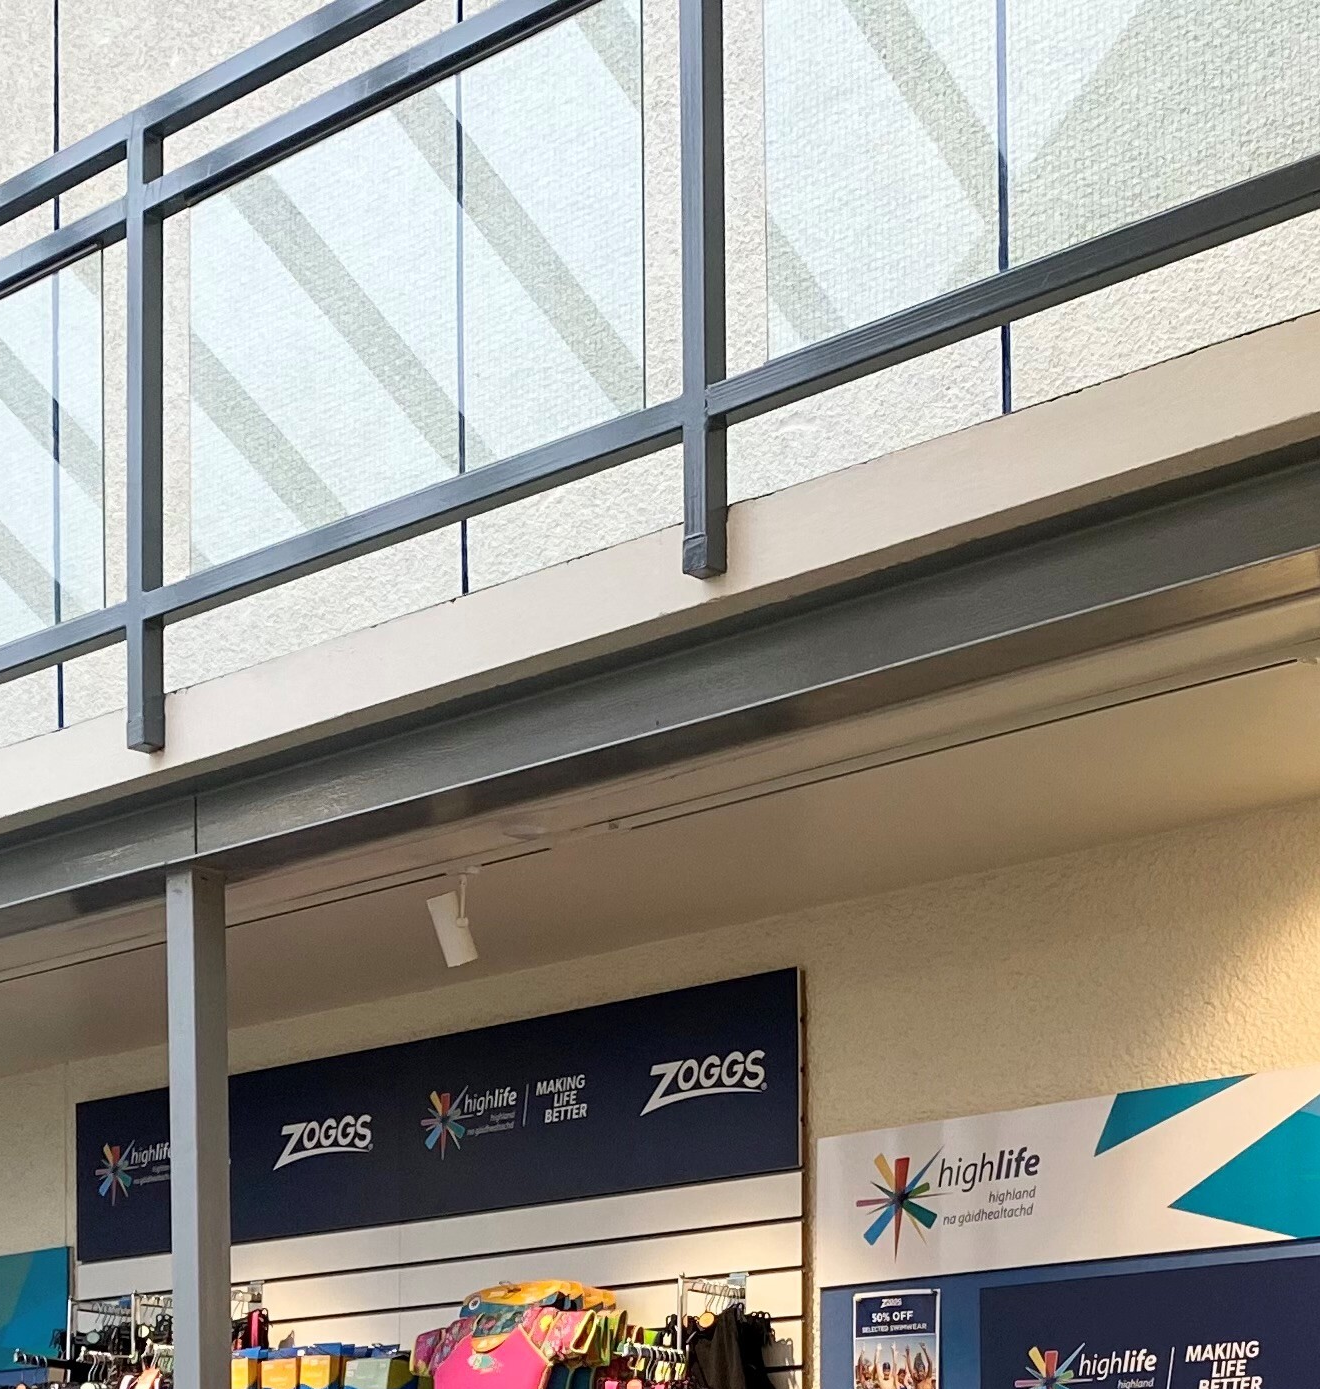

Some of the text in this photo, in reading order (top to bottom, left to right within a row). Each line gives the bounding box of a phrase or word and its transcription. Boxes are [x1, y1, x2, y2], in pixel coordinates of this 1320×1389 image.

[535, 1074, 585, 1096] MAKING
[640, 1050, 765, 1116] ZOGGS
[464, 1087, 518, 1116] highlife
[553, 1091, 577, 1107] LIFE
[544, 1103, 588, 1124] BETTER
[273, 1114, 372, 1170] ZOGGS
[938, 1145, 1040, 1193] highlife
[988, 1186, 1036, 1204] highland
[943, 1213, 956, 1226] na
[871, 1310, 913, 1323] 50% OFF
[890, 1322, 928, 1332] SWIMWEAR
[1185, 1340, 1259, 1363] MAKING
[1078, 1349, 1157, 1381] highlife
[1211, 1359, 1247, 1378] LIFE
[1117, 1377, 1155, 1389] highland
